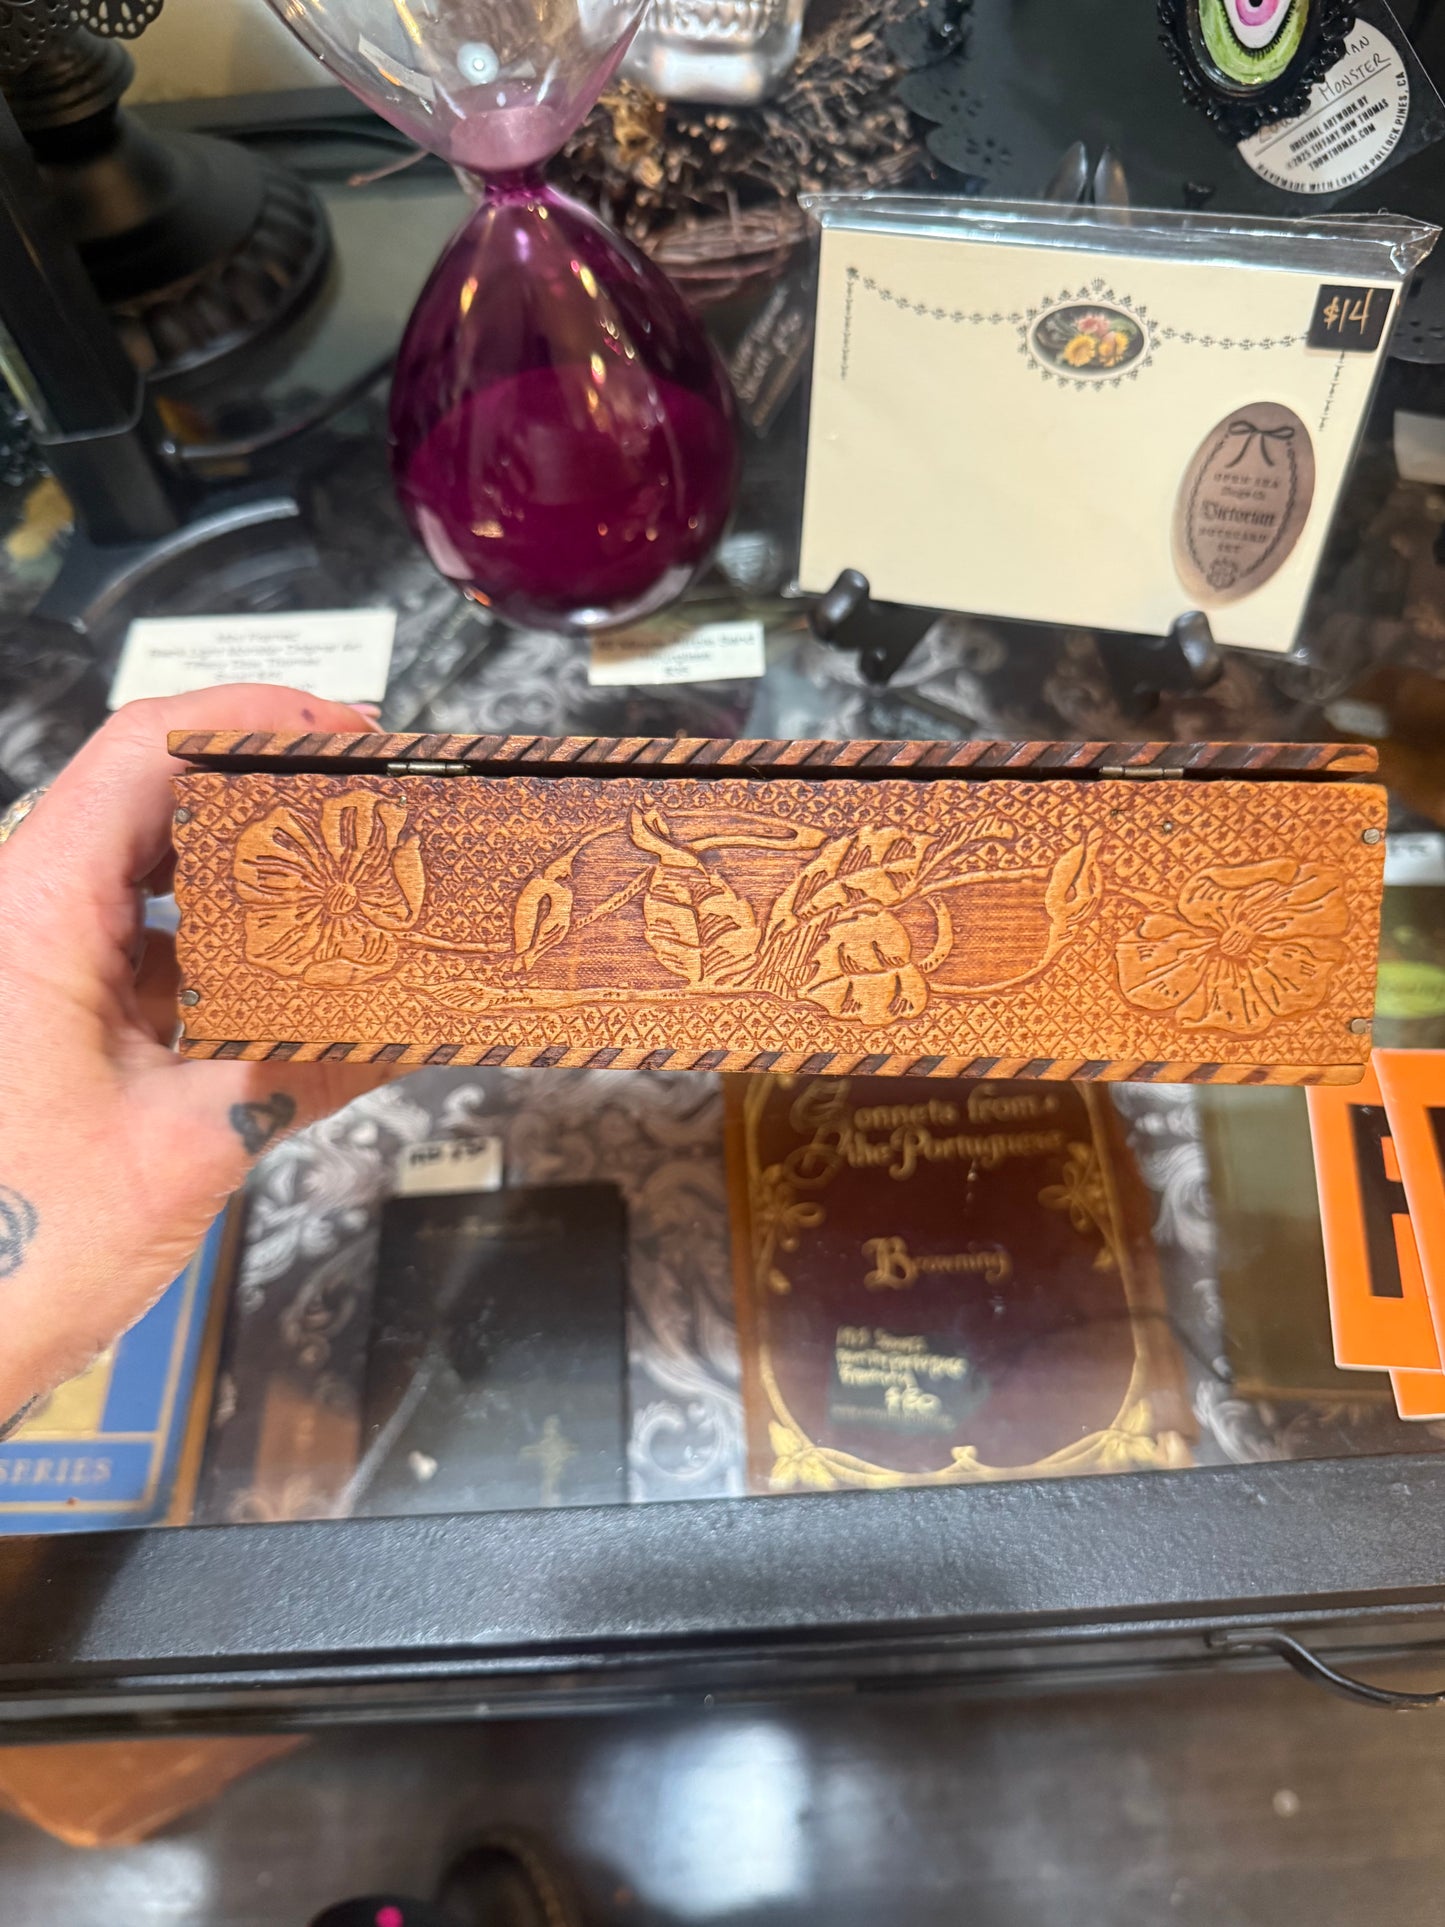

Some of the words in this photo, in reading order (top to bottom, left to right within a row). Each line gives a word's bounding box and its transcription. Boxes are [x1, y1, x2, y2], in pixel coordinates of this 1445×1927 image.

[1346, 35, 1370, 56] AN
[1318, 52, 1391, 102] MONSTER
[1289, 126, 1325, 153] ORIGINAL
[1322, 102, 1359, 131] ARTWORK
[1357, 95, 1369, 108] BY
[1308, 122, 1377, 172] TDOWTHOMAS.COM
[1309, 180, 1334, 192] WITH
[1336, 171, 1359, 188] LOVE
[1358, 163, 1371, 175] IN
[1369, 127, 1401, 167] POLLOCK
[1395, 71, 1408, 87] CA
[1310, 130, 1341, 154] TIFFANY
[1340, 119, 1358, 135] DOW
[1356, 98, 1390, 124] THOMAS
[1323, 288, 1374, 335] $14
